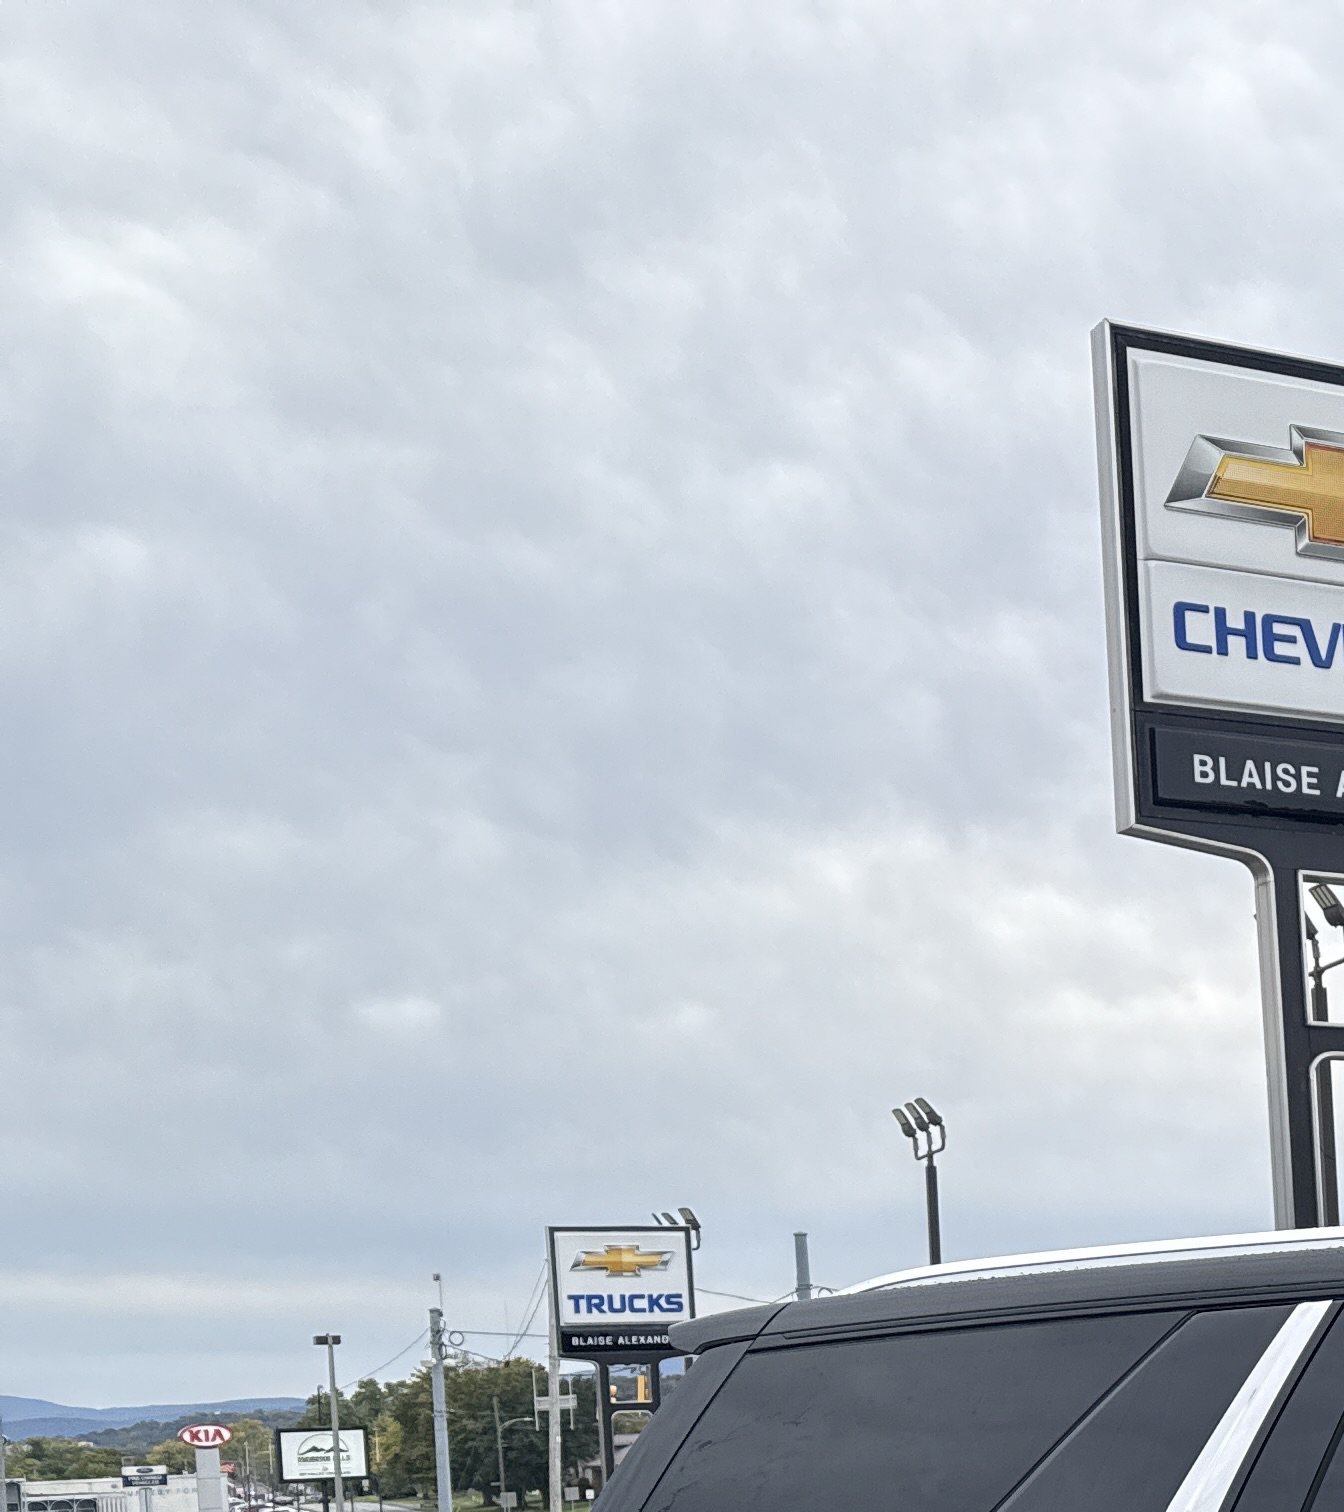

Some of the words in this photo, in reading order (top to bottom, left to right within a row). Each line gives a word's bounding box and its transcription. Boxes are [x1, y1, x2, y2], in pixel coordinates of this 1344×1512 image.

[1193, 754, 1321, 796] BLAISE
[567, 1293, 684, 1314] TRUCKS
[571, 1335, 613, 1346] BLAISE
[617, 1335, 670, 1346] ALEXAND
[188, 1429, 226, 1442] KIA
